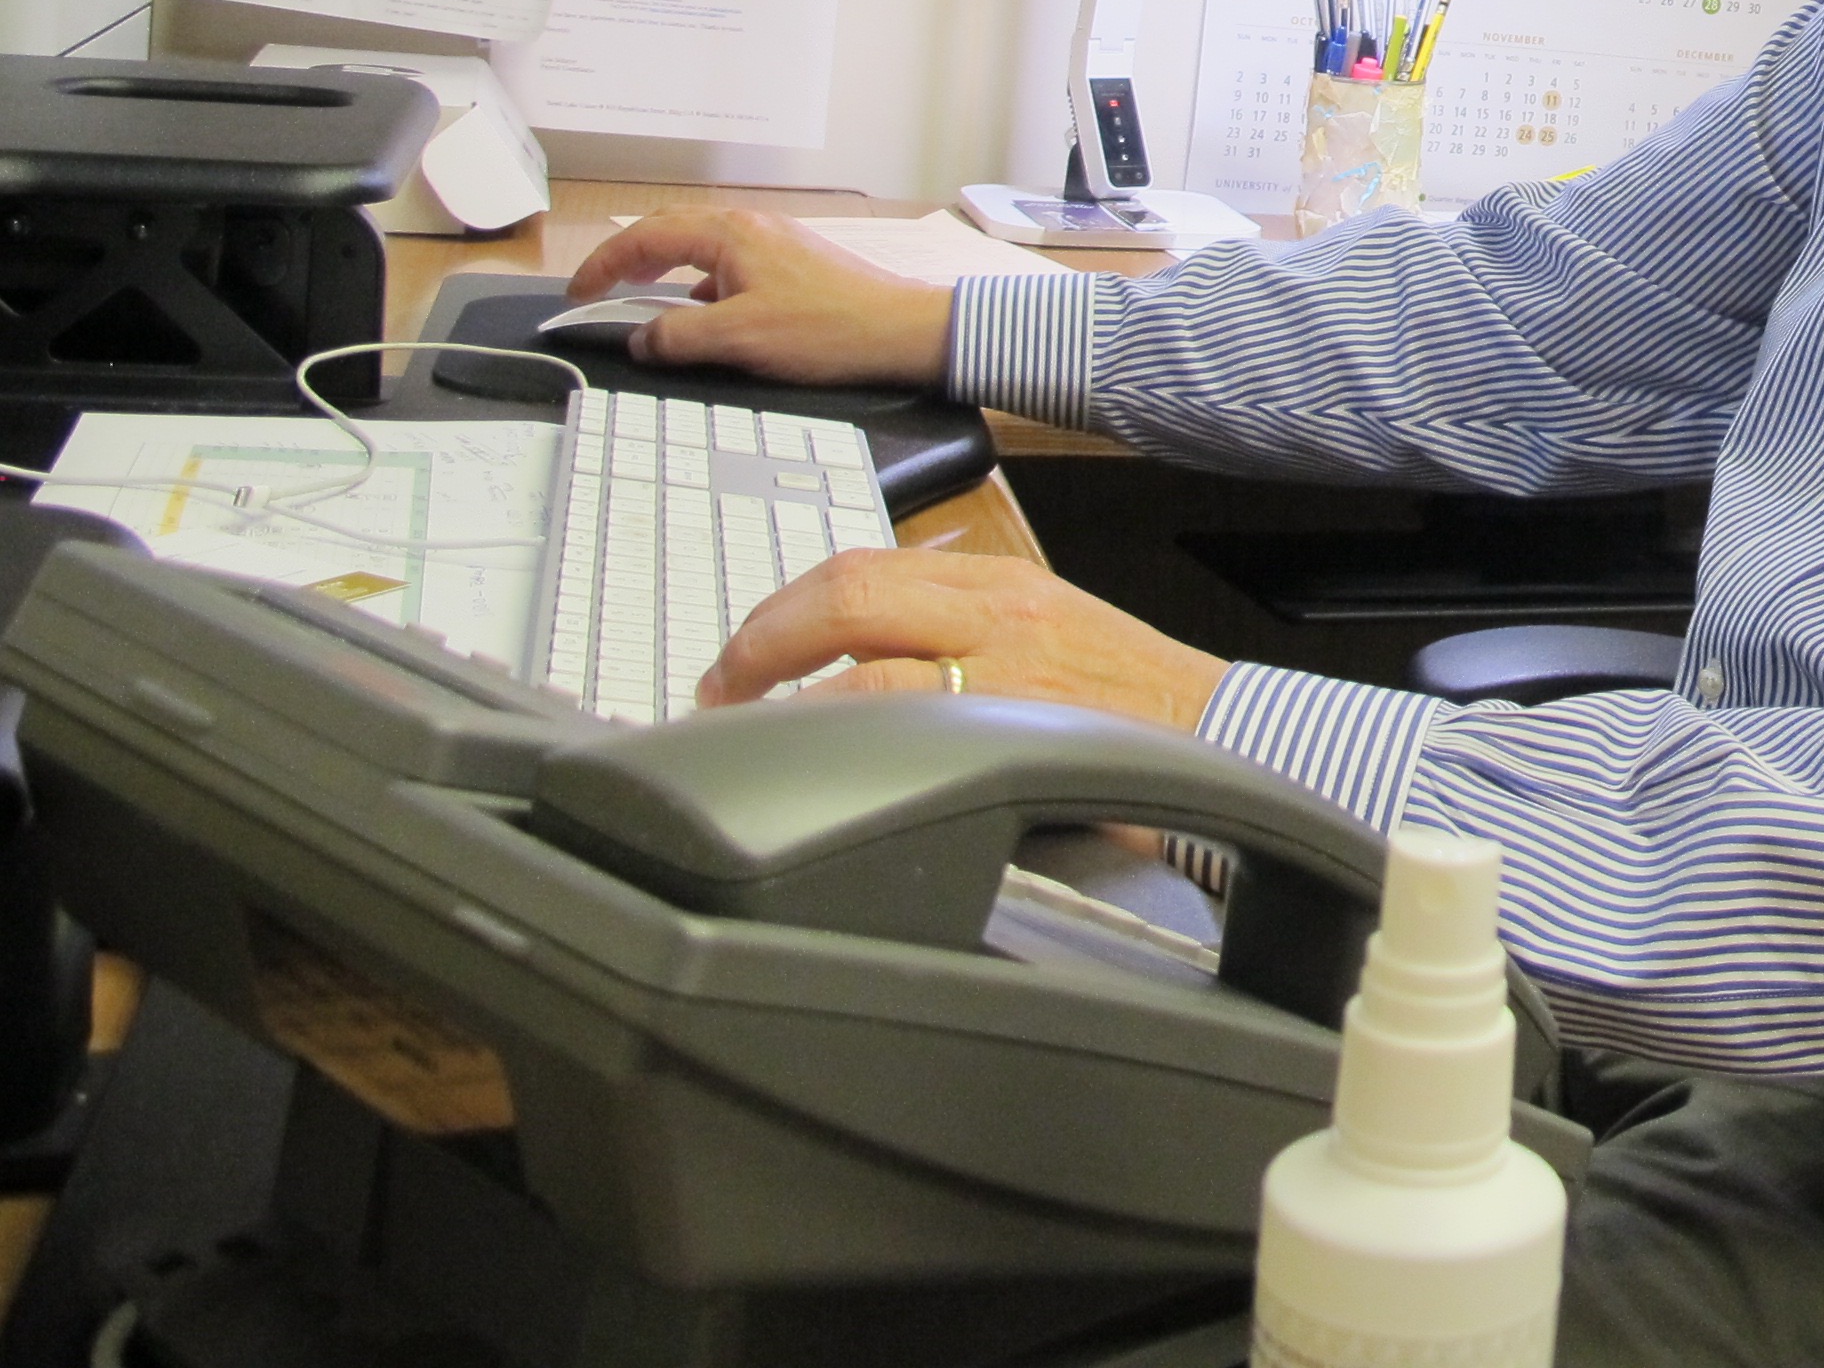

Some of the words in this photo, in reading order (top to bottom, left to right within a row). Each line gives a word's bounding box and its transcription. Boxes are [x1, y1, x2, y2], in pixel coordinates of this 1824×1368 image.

[1704, 0, 1717, 10] 28
[1727, 2, 1740, 12] 29
[1748, 4, 1761, 14] 30
[1482, 31, 1546, 47] NOVEMBER
[1676, 49, 1735, 63] DECEMBER
[1215, 178, 1280, 193] UNIVERSITY
